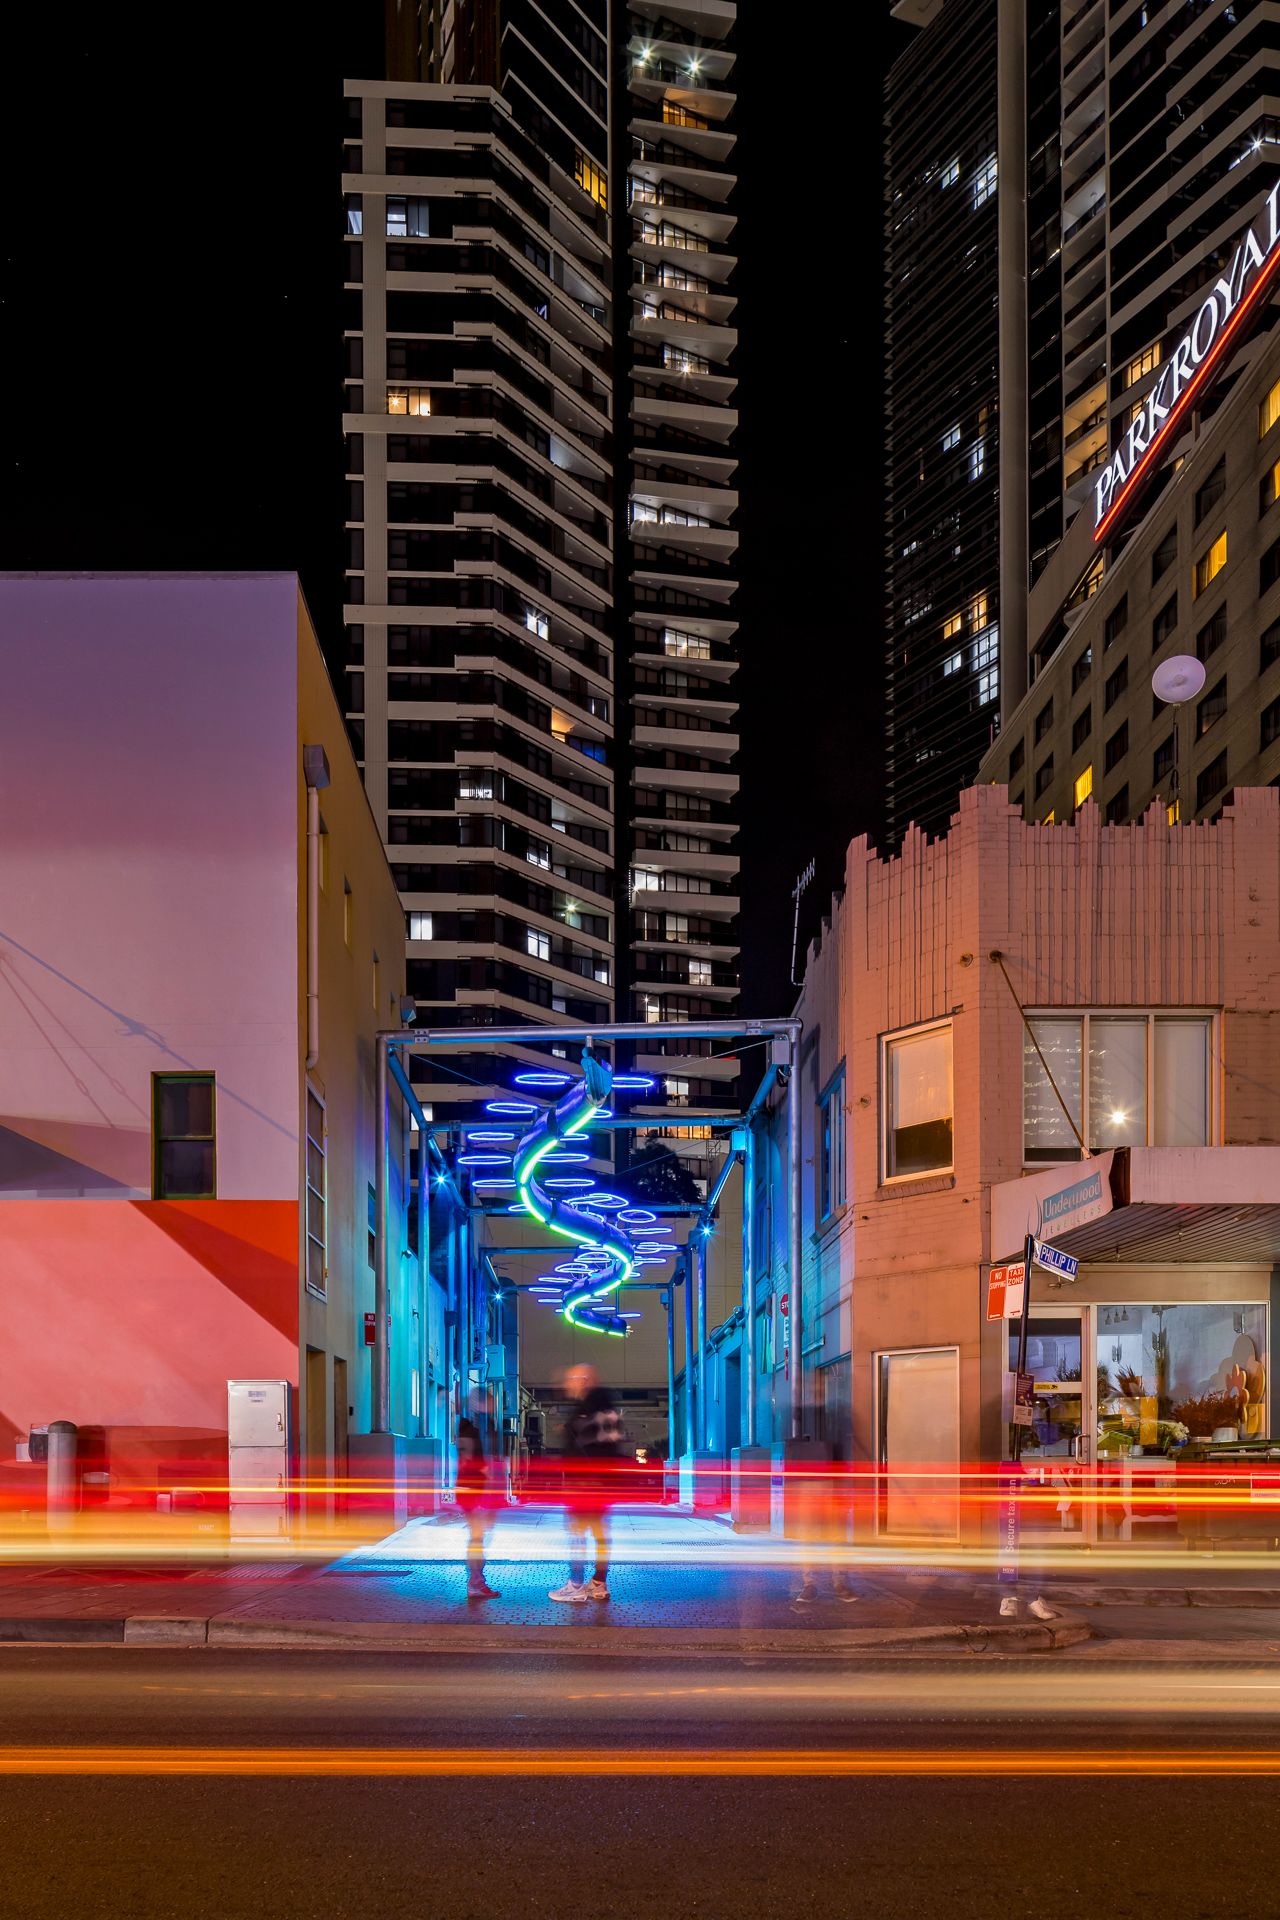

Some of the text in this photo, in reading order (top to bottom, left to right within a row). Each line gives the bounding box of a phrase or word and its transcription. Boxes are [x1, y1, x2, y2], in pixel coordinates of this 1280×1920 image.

[1044, 1174, 1101, 1218] Underwood
[1041, 1247, 1066, 1268] PHILLIP
[1067, 1259, 1077, 1274] LN
[995, 1272, 1003, 1280] NO
[1008, 1276, 1023, 1285] ZONE
[1009, 1268, 1023, 1277] TAXI
[1005, 1518, 1015, 1553] Secure
